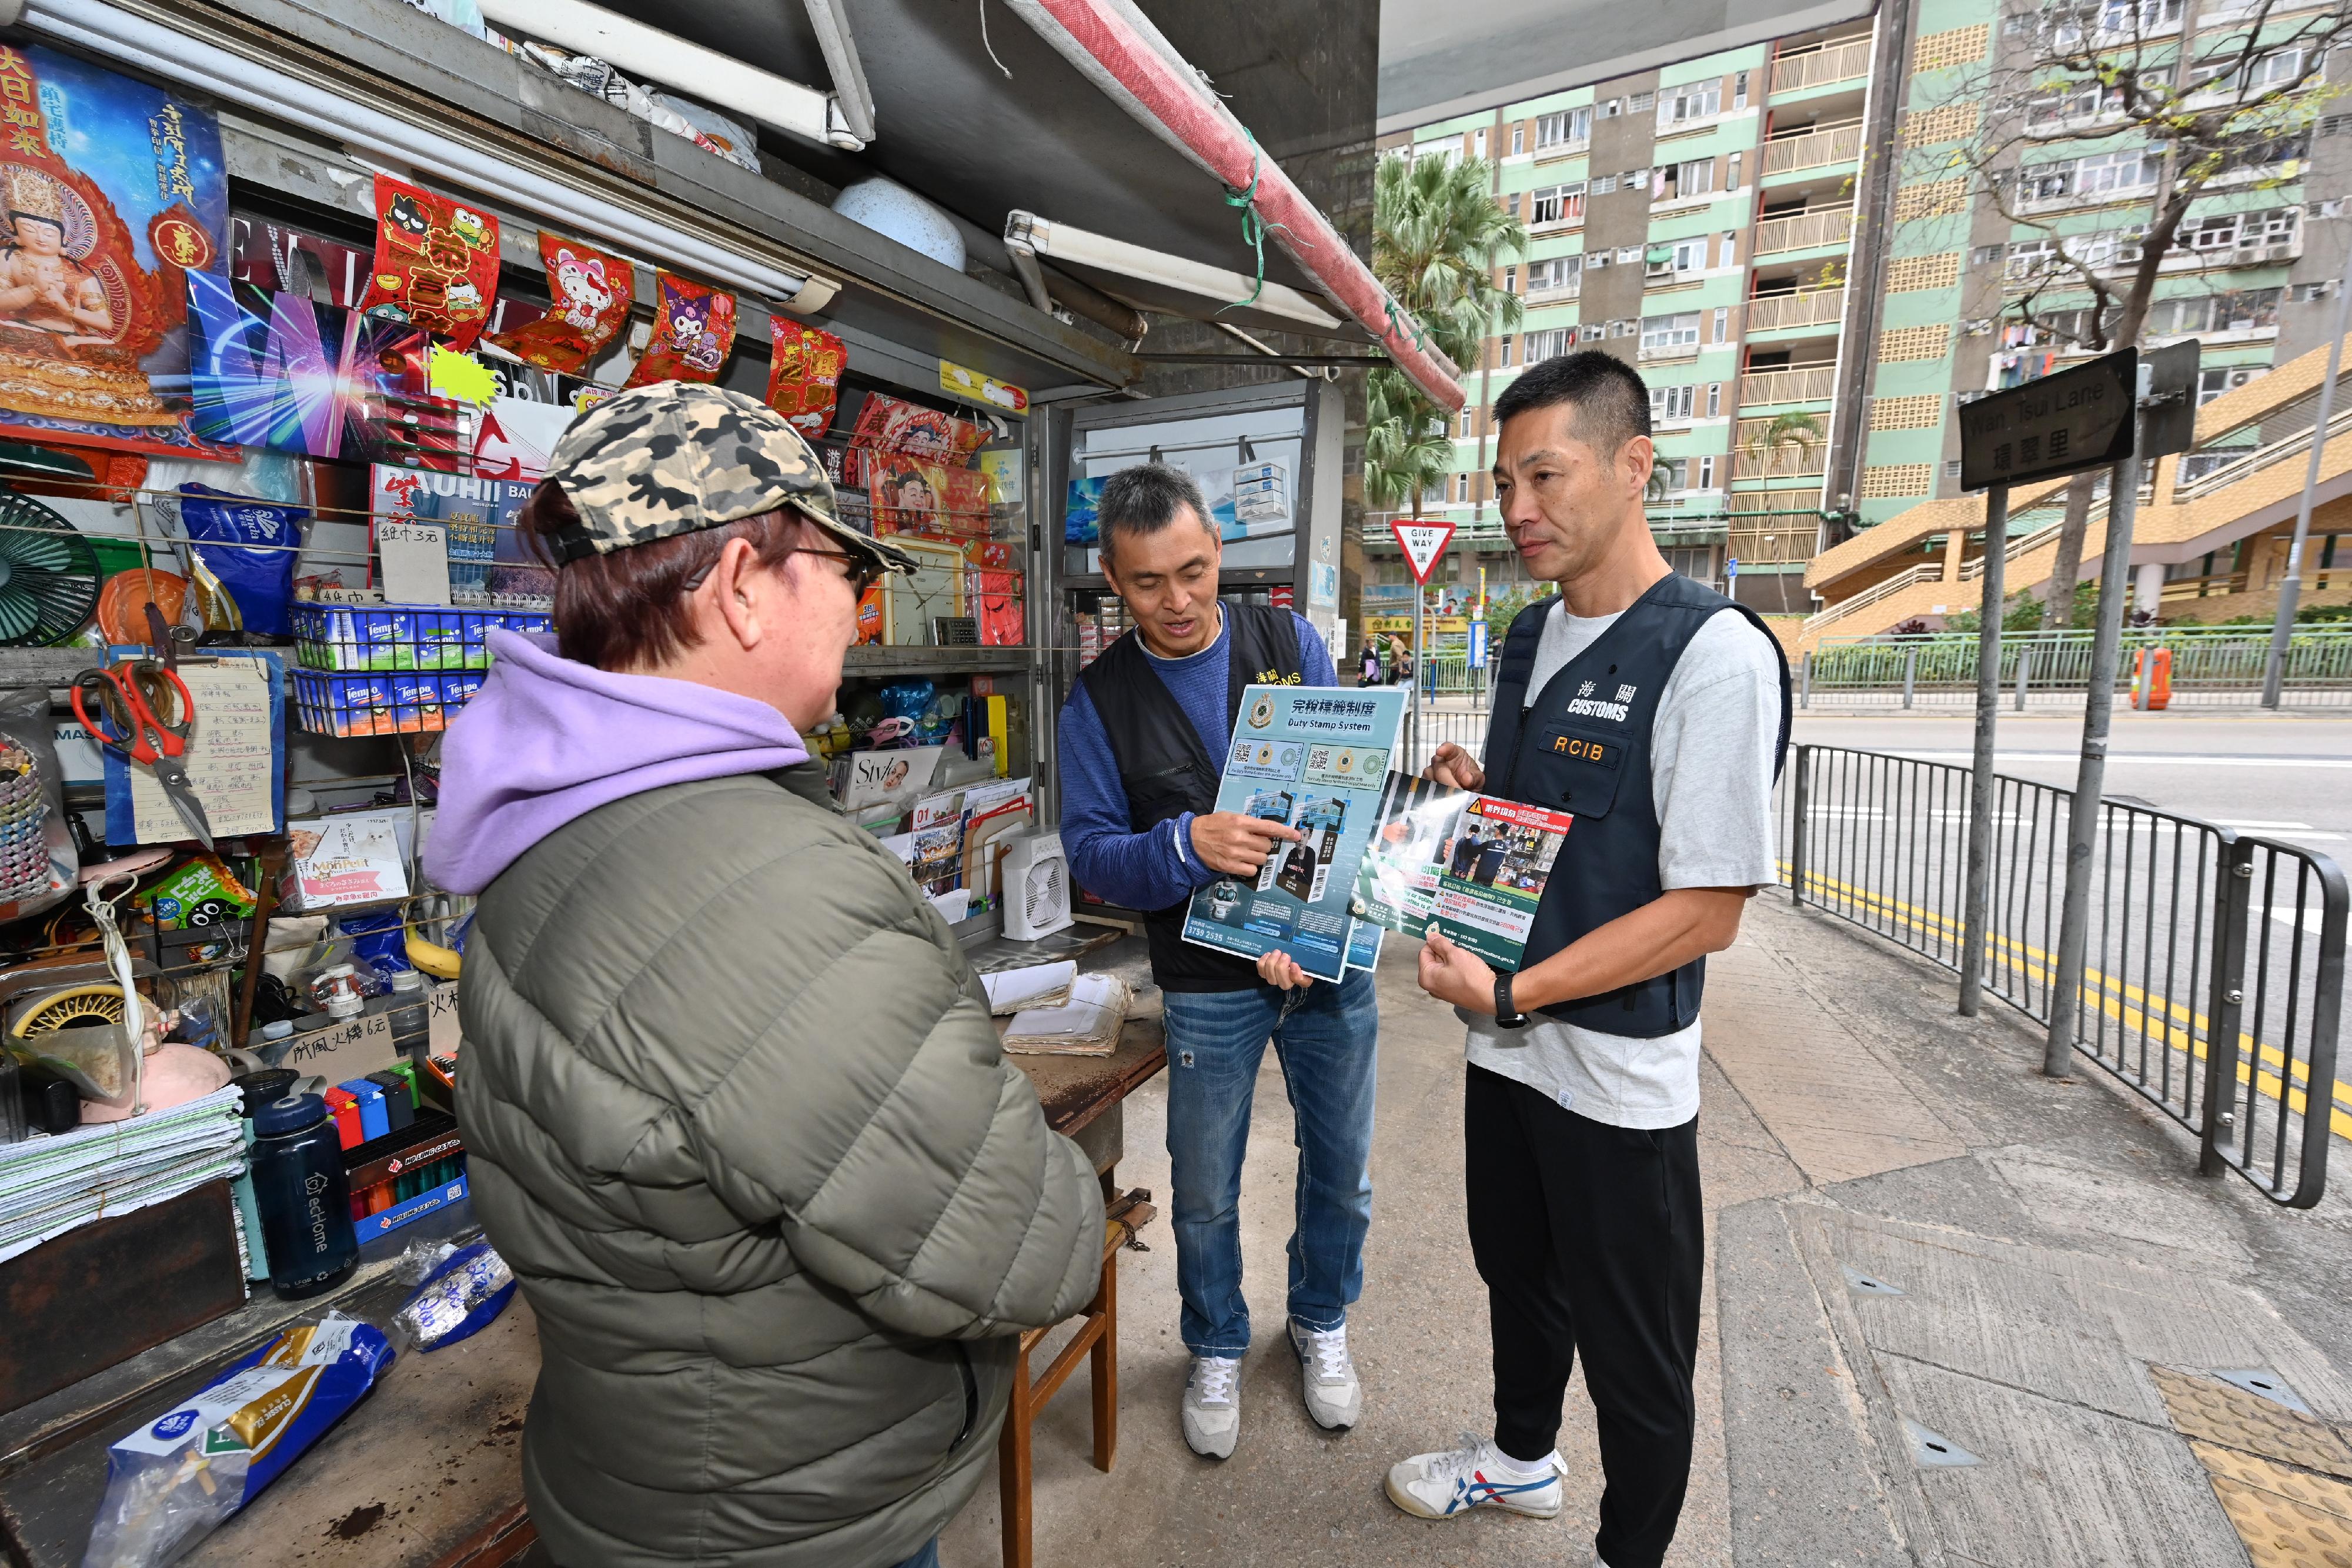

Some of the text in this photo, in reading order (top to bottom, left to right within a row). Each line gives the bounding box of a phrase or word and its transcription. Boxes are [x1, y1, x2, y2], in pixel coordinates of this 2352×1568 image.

[1967, 381, 2104, 436] Wan Tsui Lane
[240, 509, 260, 540] Vinda
[1411, 529, 1434, 537] GIVE
[363, 622, 401, 636] Tempo
[470, 623, 500, 636] Tempo
[422, 636, 455, 648] Tempo
[1255, 668, 1279, 684] 海關
[342, 686, 380, 701] Tempo
[394, 684, 432, 698] Tempo
[447, 683, 479, 695] Tempo
[1577, 680, 1637, 704] 海關
[1290, 698, 1378, 718] 完稅標籤制度
[1567, 698, 1629, 722] CUSTOMS
[1288, 718, 1371, 731] Duty Stamp System
[1553, 735, 1603, 761] RCIB
[917, 807, 929, 823] 01
[312, 858, 369, 872] Mon Petit
[1188, 926, 1223, 942] 3759 2535
[416, 1148, 435, 1161] LUNG
[435, 1142, 450, 1153] C&T
[450, 1139, 460, 1147] Co.
[417, 1202, 430, 1212] C&T
[308, 1196, 329, 1254] ecHome
[294, 1278, 312, 1286] LFGB
[265, 1398, 292, 1422] CLASSIC
